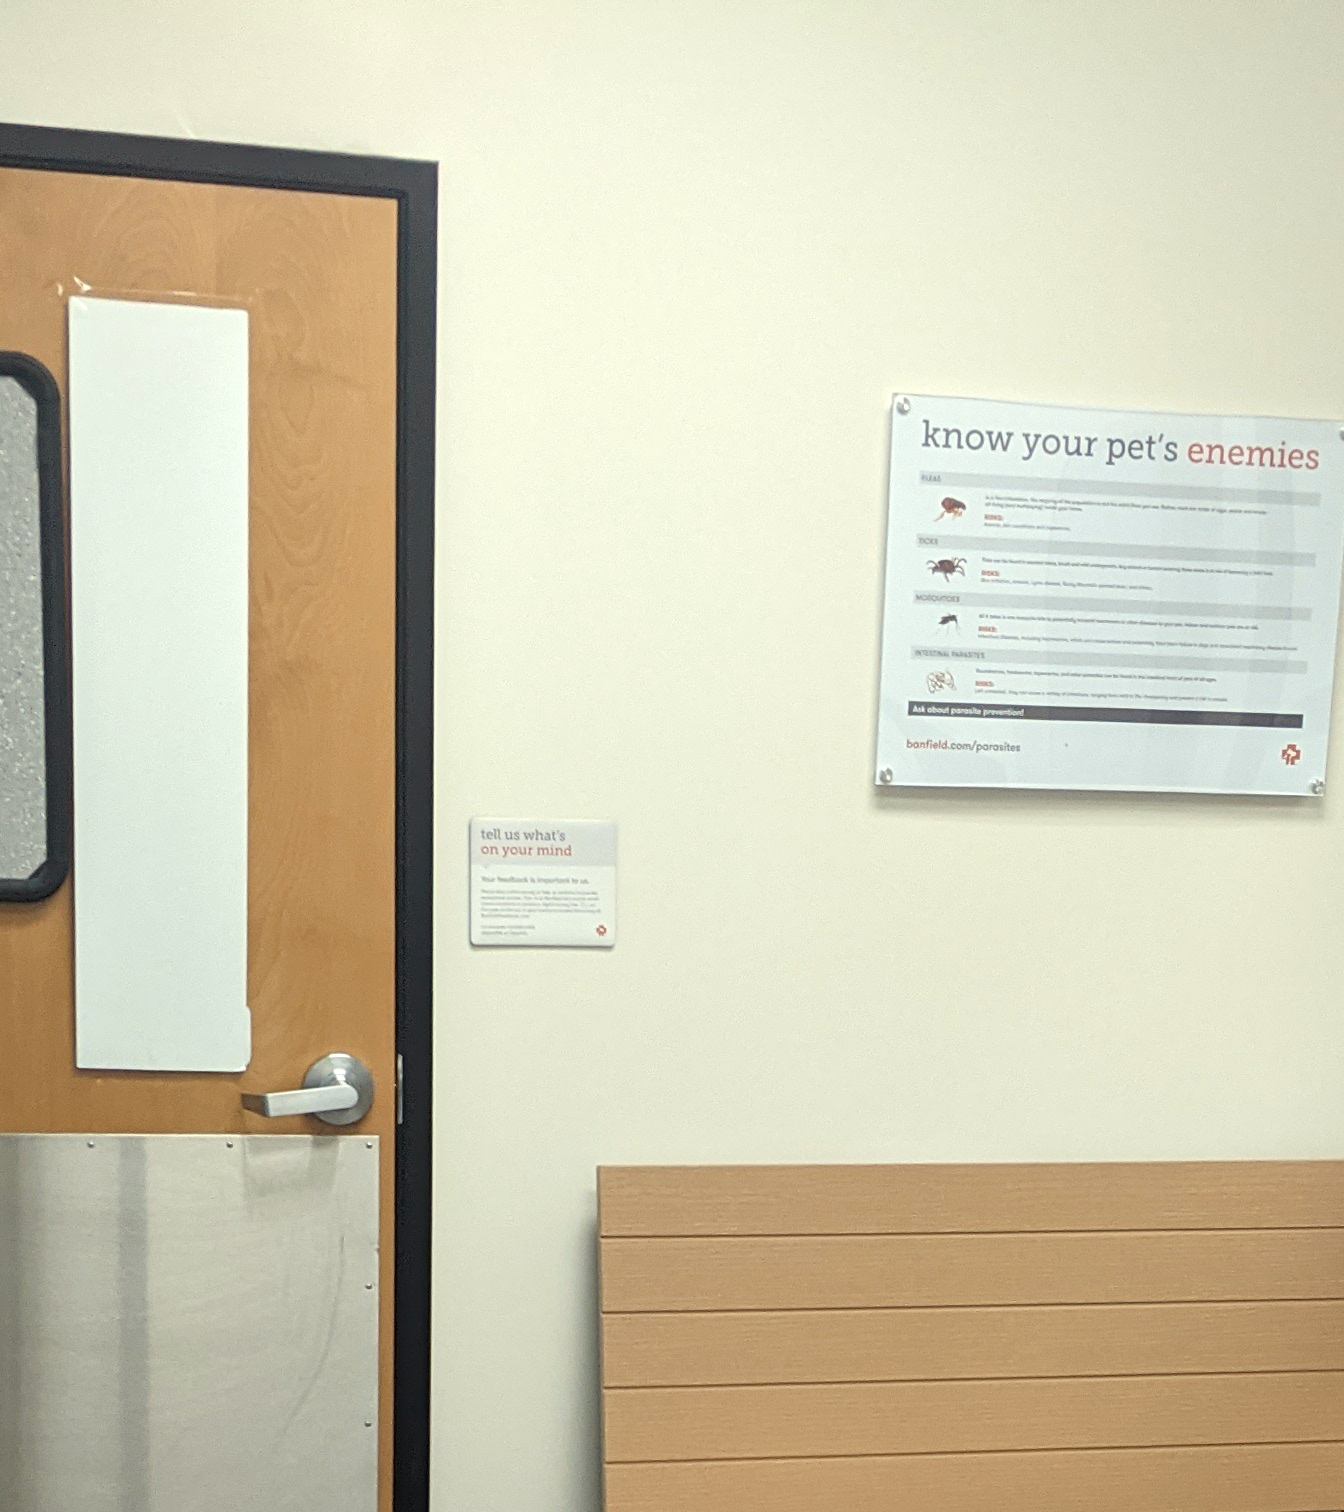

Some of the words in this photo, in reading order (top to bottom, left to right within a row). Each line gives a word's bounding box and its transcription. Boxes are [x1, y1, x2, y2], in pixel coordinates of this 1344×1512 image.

[921, 419, 1014, 453] know
[1022, 431, 1098, 460] your
[1105, 433, 1179, 465] pet's
[1187, 440, 1321, 470] enemies
[912, 704, 925, 713] Ask
[926, 706, 950, 714] about
[950, 706, 982, 716] parasite
[906, 739, 1021, 753] banfield.com/parasites
[480, 828, 501, 840] tell
[504, 830, 520, 840] us
[523, 829, 566, 841] what's
[480, 845, 499, 855] on
[502, 846, 533, 858] your
[536, 845, 573, 857] mind
